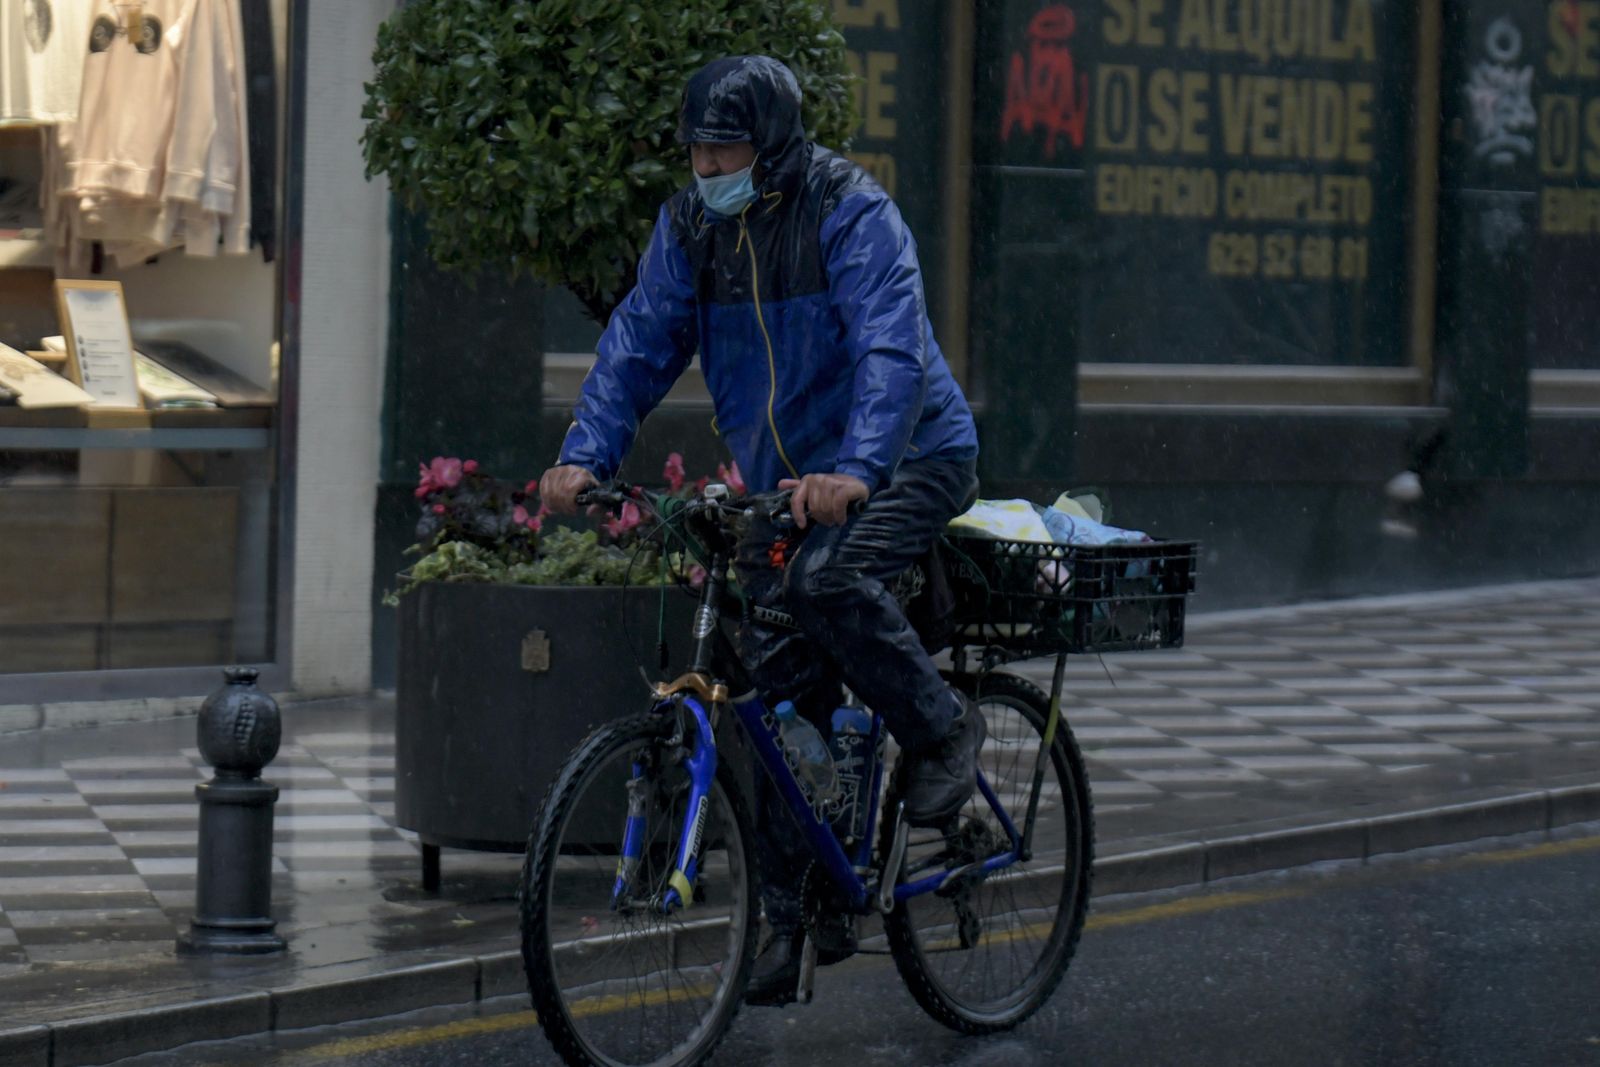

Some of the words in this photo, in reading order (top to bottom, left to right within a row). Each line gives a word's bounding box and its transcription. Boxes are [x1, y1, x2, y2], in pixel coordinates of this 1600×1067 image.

[1101, 0, 1166, 46] SE
[1176, 0, 1376, 63] ALQUILA
[1146, 68, 1210, 152] SE
[1217, 73, 1374, 162] VENDE
[1095, 162, 1218, 219] EDIFICIO
[1225, 168, 1374, 225] COMPLETO
